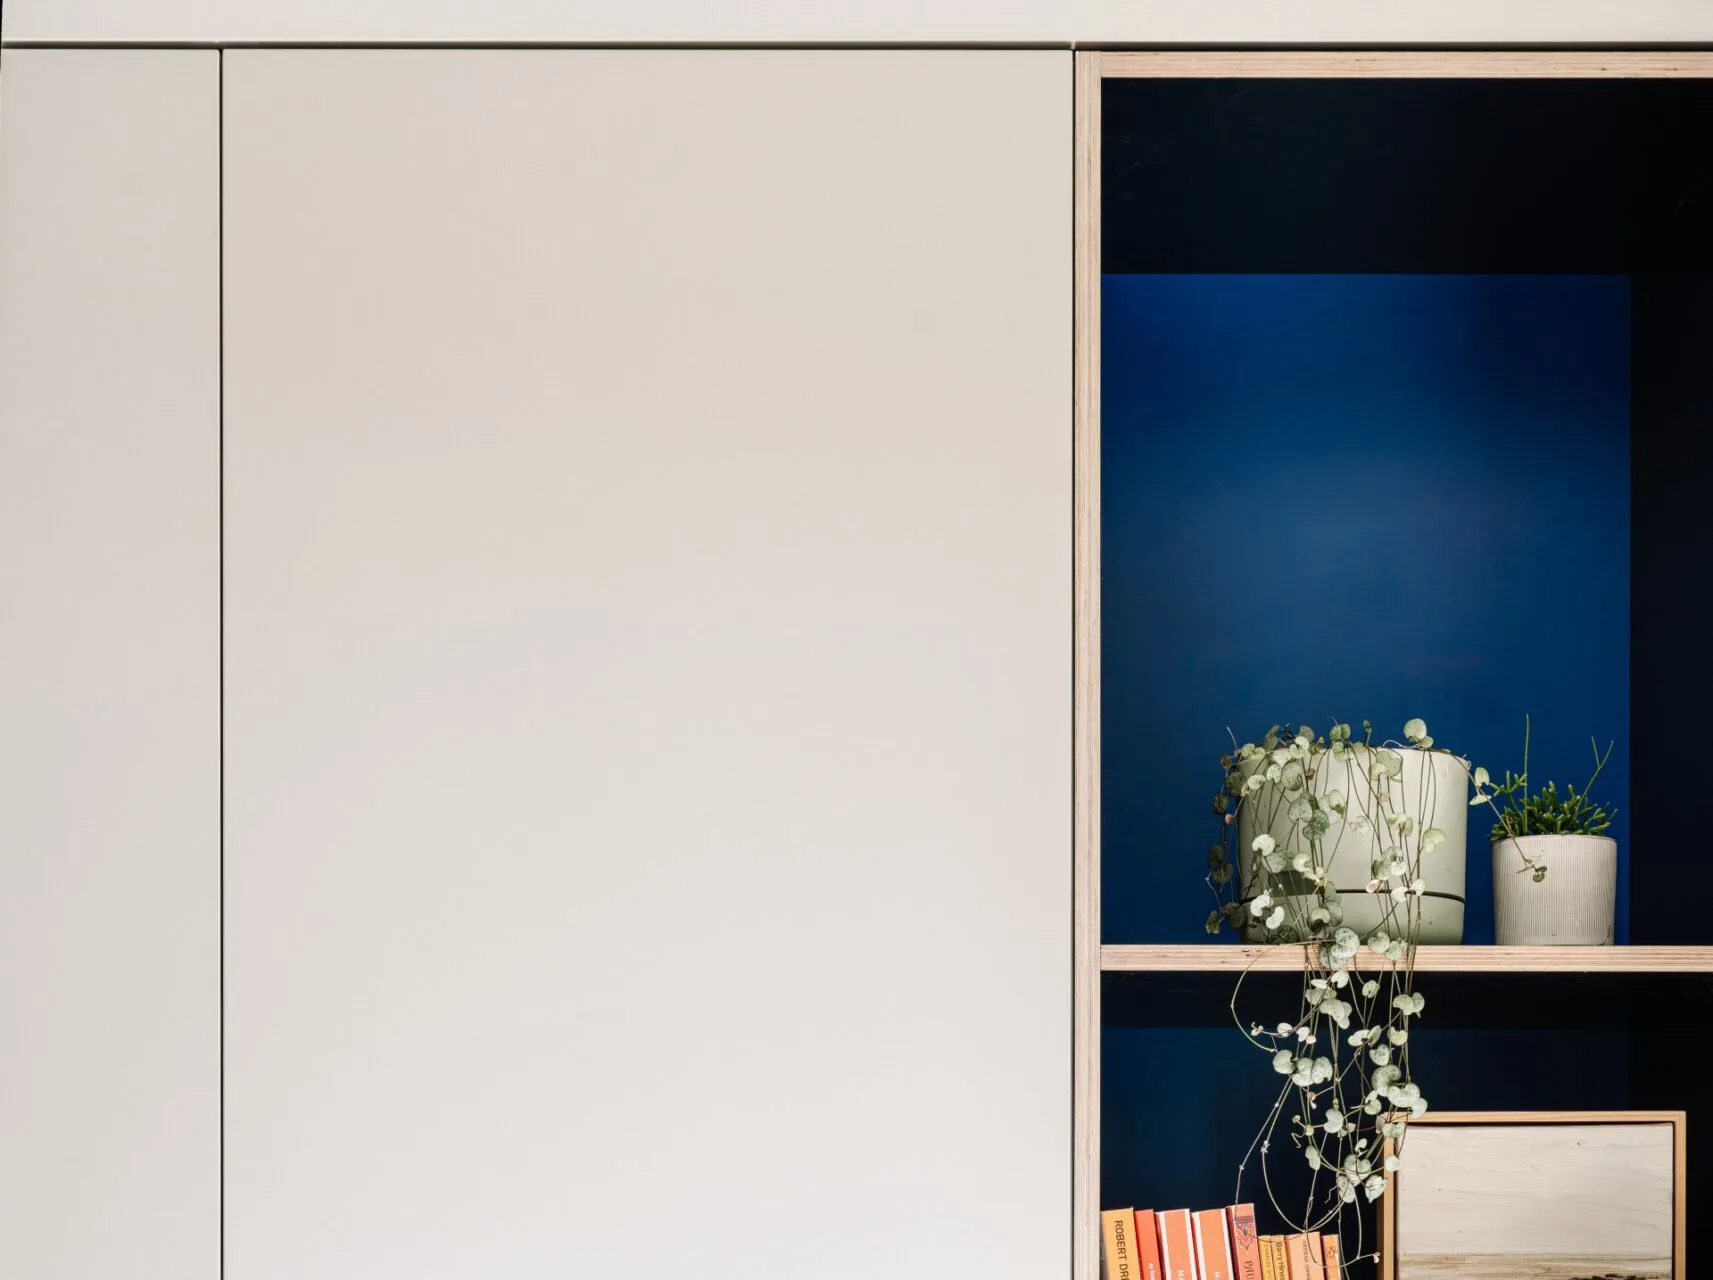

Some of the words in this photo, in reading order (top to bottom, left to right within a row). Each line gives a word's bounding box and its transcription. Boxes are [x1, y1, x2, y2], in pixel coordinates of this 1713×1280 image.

[1113, 1220, 1126, 1259] ROBERT
[1274, 1242, 1283, 1261] Barry
[1277, 1261, 1286, 1280] Hines
